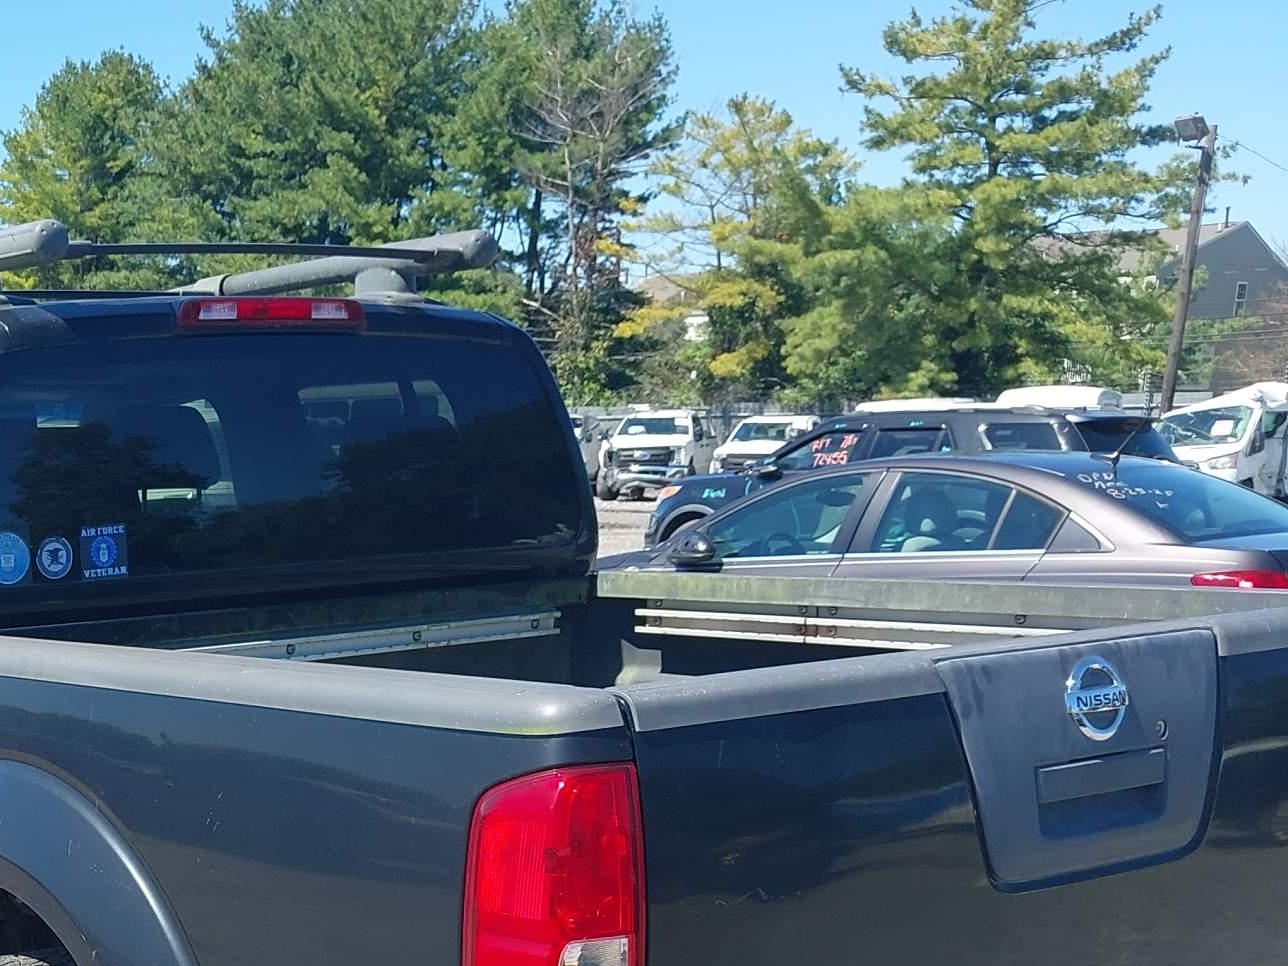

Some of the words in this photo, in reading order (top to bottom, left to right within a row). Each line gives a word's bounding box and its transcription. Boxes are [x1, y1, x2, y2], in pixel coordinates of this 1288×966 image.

[81, 527, 96, 537] AIR
[97, 524, 125, 536] FORCE
[83, 566, 128, 578] VETERAN
[1076, 689, 1127, 708] NISSAN
